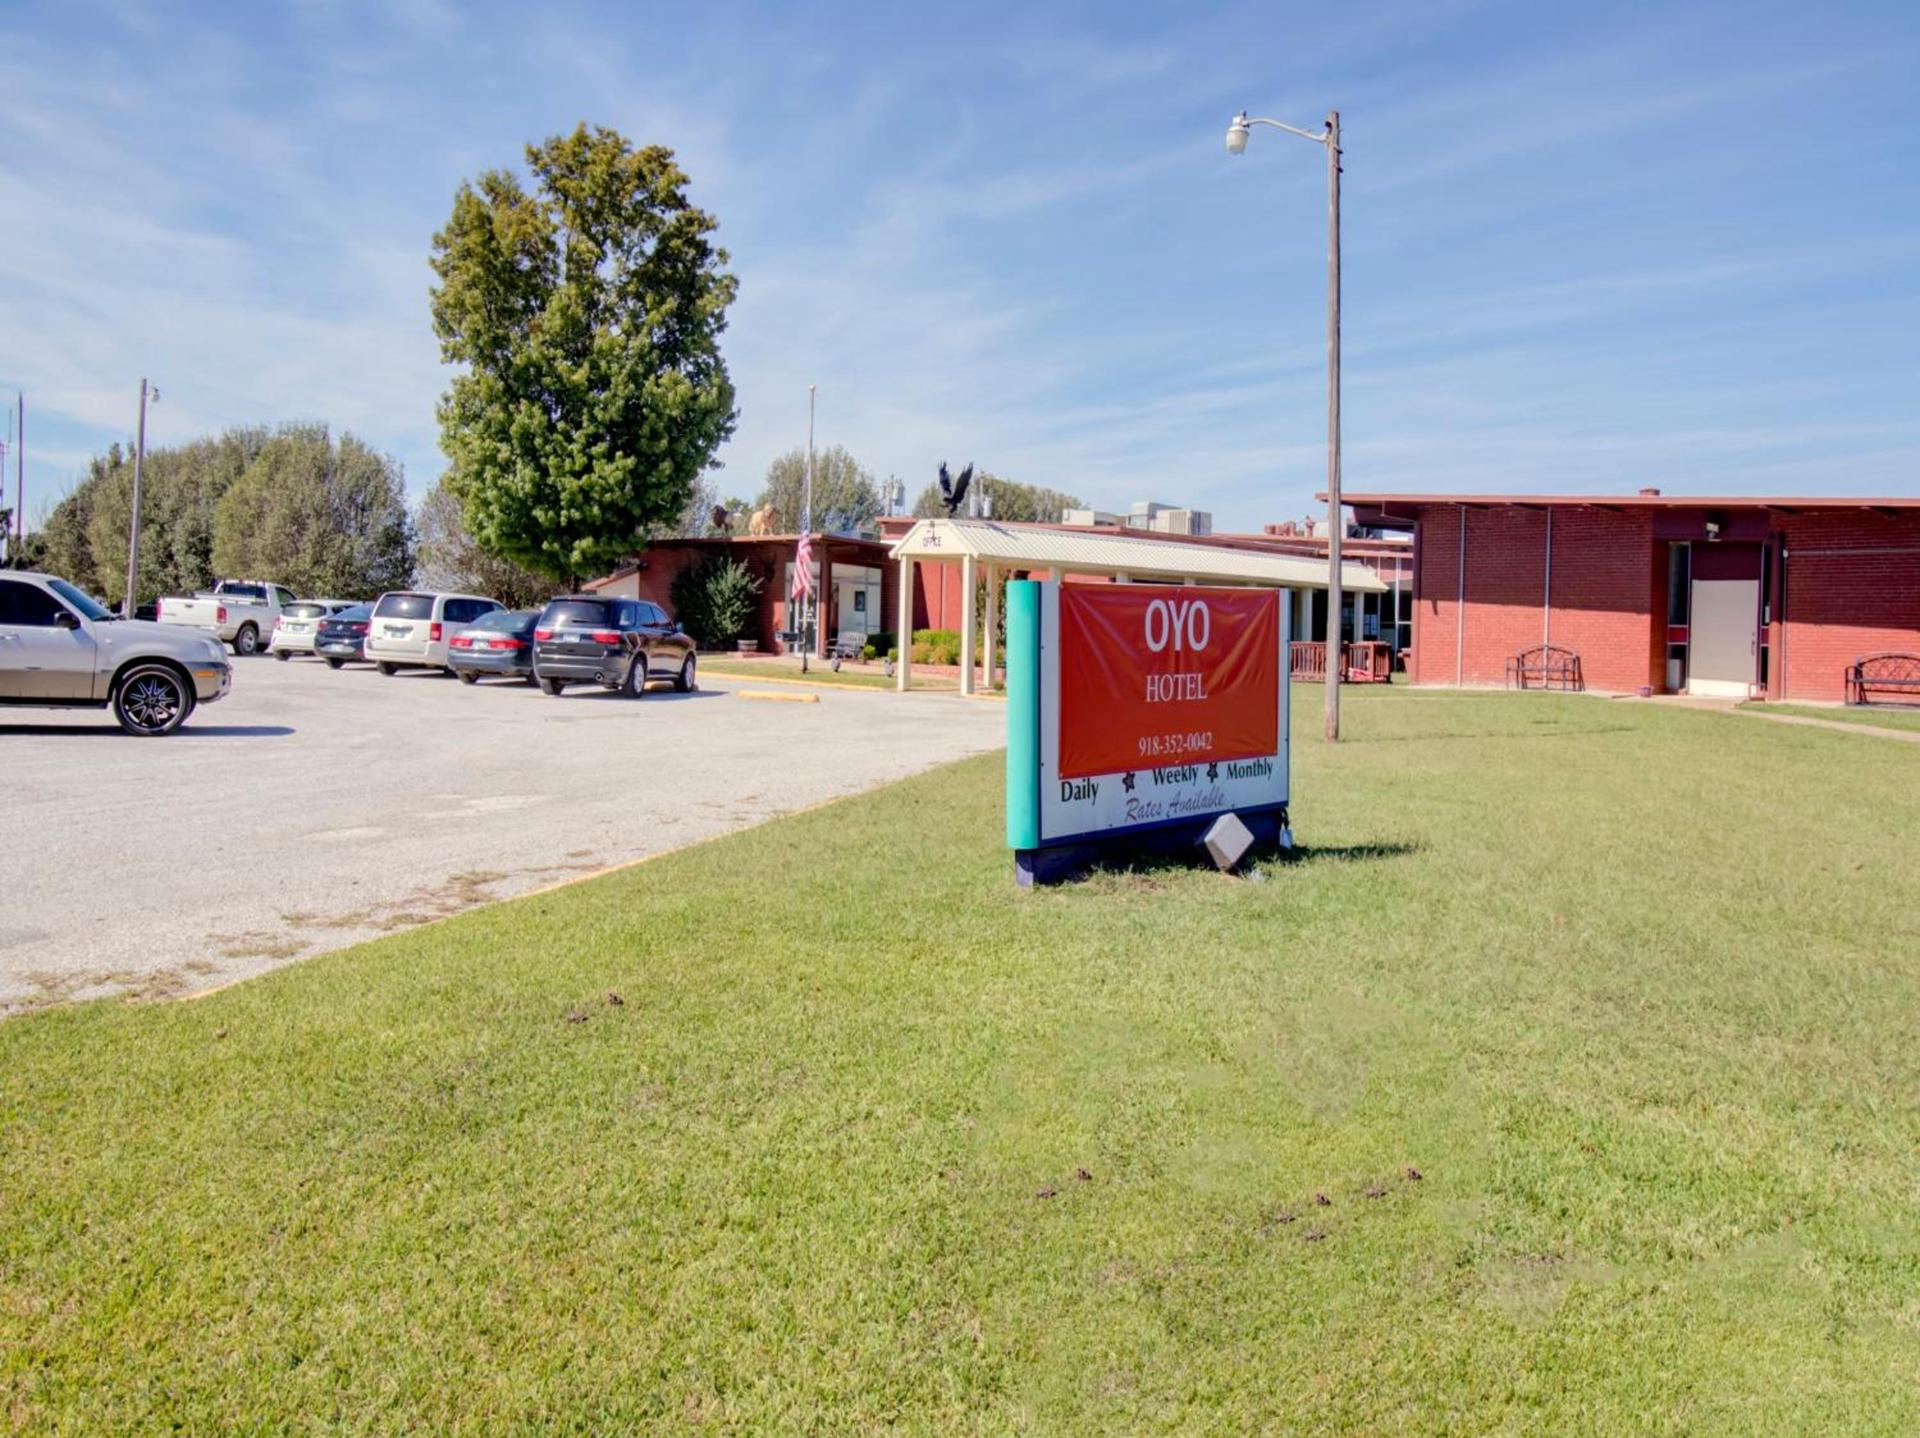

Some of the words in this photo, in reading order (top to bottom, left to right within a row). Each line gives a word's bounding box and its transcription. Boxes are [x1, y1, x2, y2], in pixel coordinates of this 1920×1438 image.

[1144, 599, 1210, 652] OYO
[1146, 674, 1207, 702] HOTEL
[1138, 732, 1212, 755] 918-352-0042
[1061, 779, 1099, 805] Daily
[1152, 766, 1198, 787] Weekly
[1227, 762, 1273, 783] Monthly
[1125, 797, 1161, 822] Rates
[1168, 787, 1224, 816] Available
